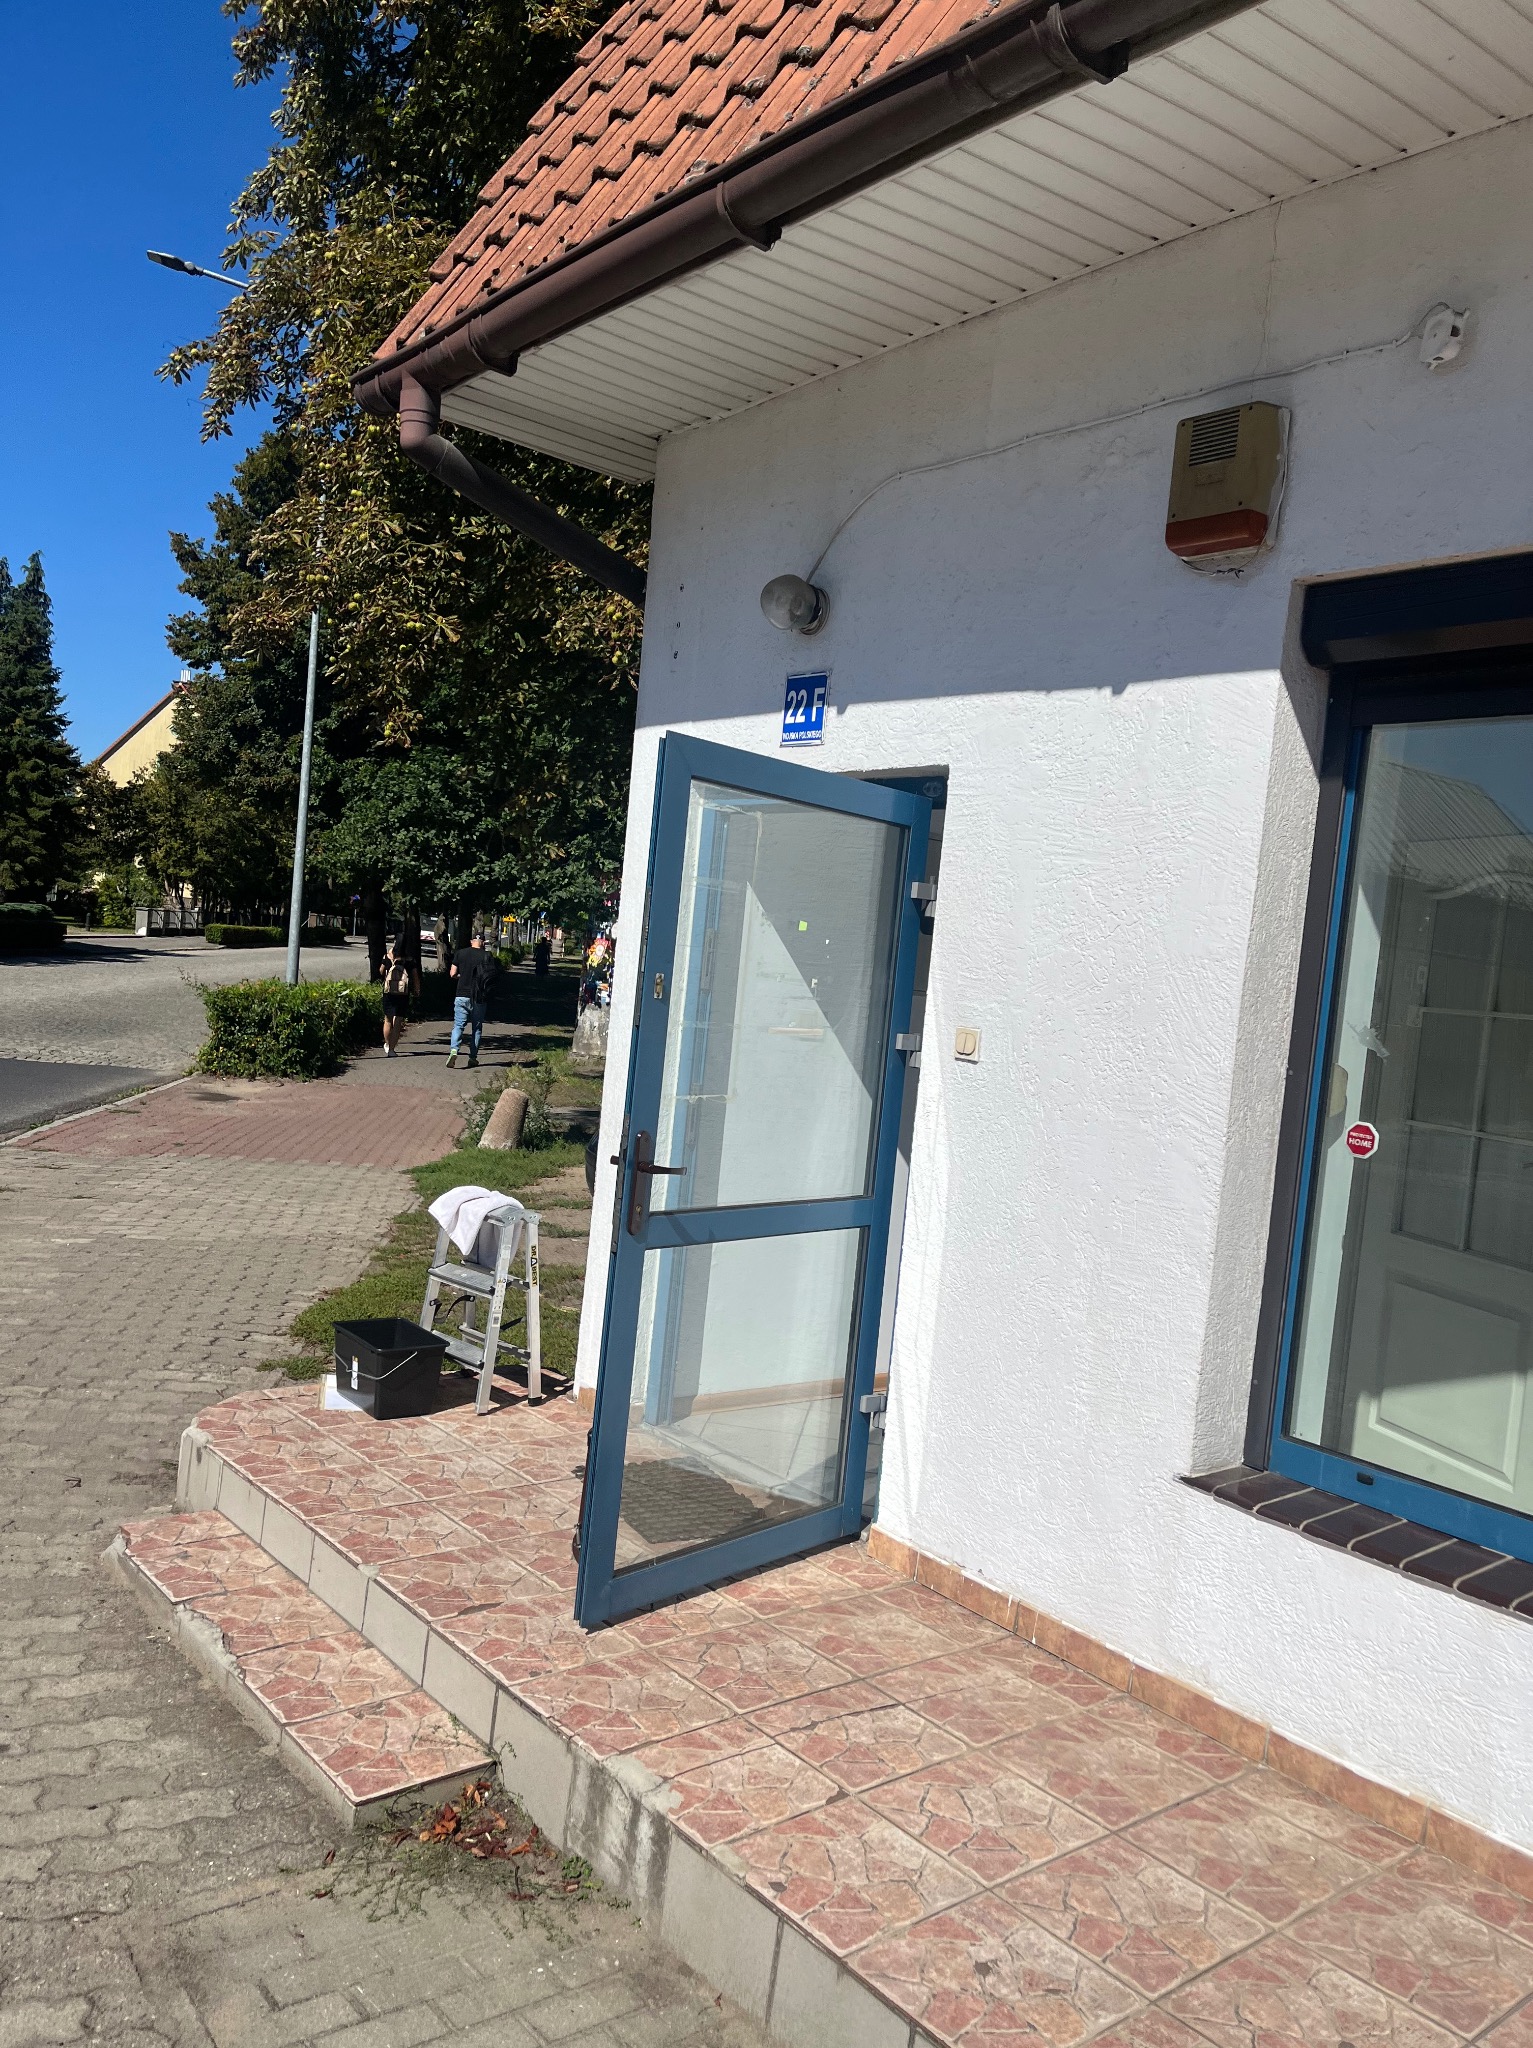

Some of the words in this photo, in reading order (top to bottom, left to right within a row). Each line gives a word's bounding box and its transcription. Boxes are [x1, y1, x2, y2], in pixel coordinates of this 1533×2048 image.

[785, 689, 807, 724] 22
[811, 687, 826, 722] F
[1348, 1138, 1373, 1148] HOME
